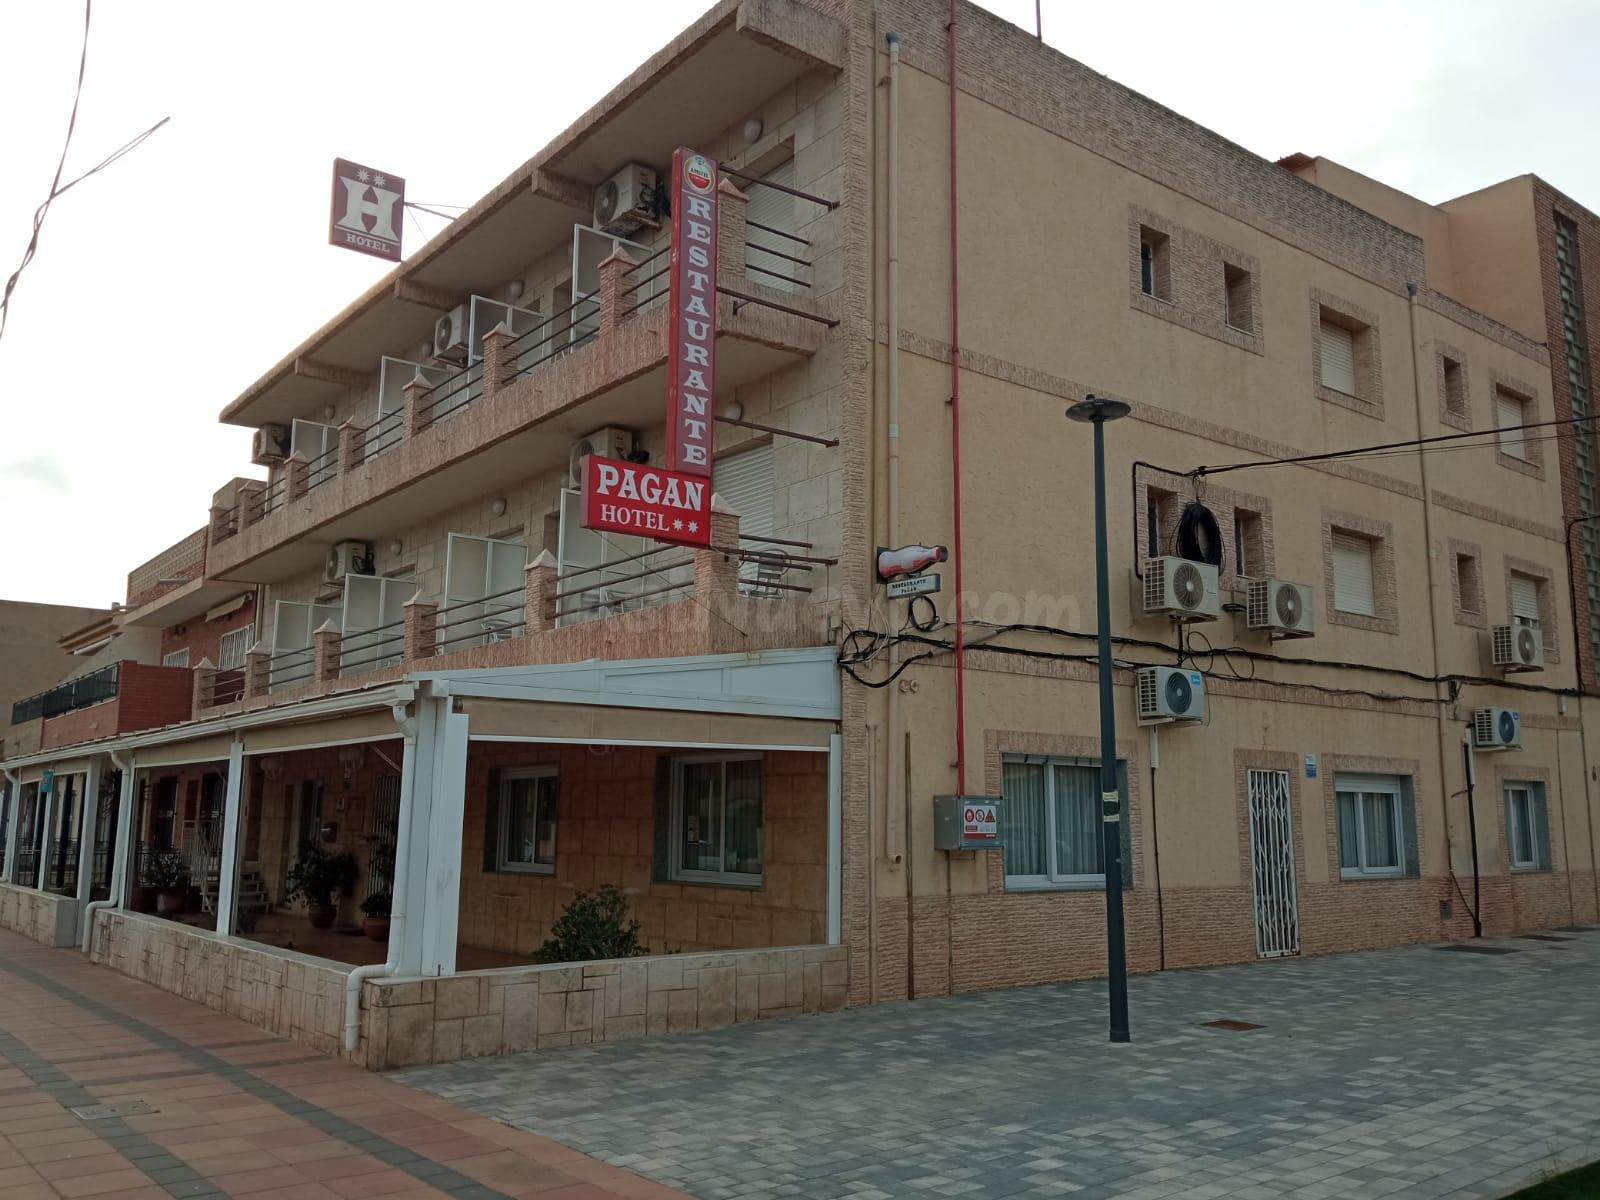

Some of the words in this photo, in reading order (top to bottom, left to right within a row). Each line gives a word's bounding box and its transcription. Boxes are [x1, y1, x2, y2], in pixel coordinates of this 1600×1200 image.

[337, 175, 401, 241] H
[346, 232, 390, 253] HOTEL
[683, 196, 712, 466] RESTAURANTE
[596, 463, 705, 512] PAGAN
[600, 503, 670, 532] HOTEL
